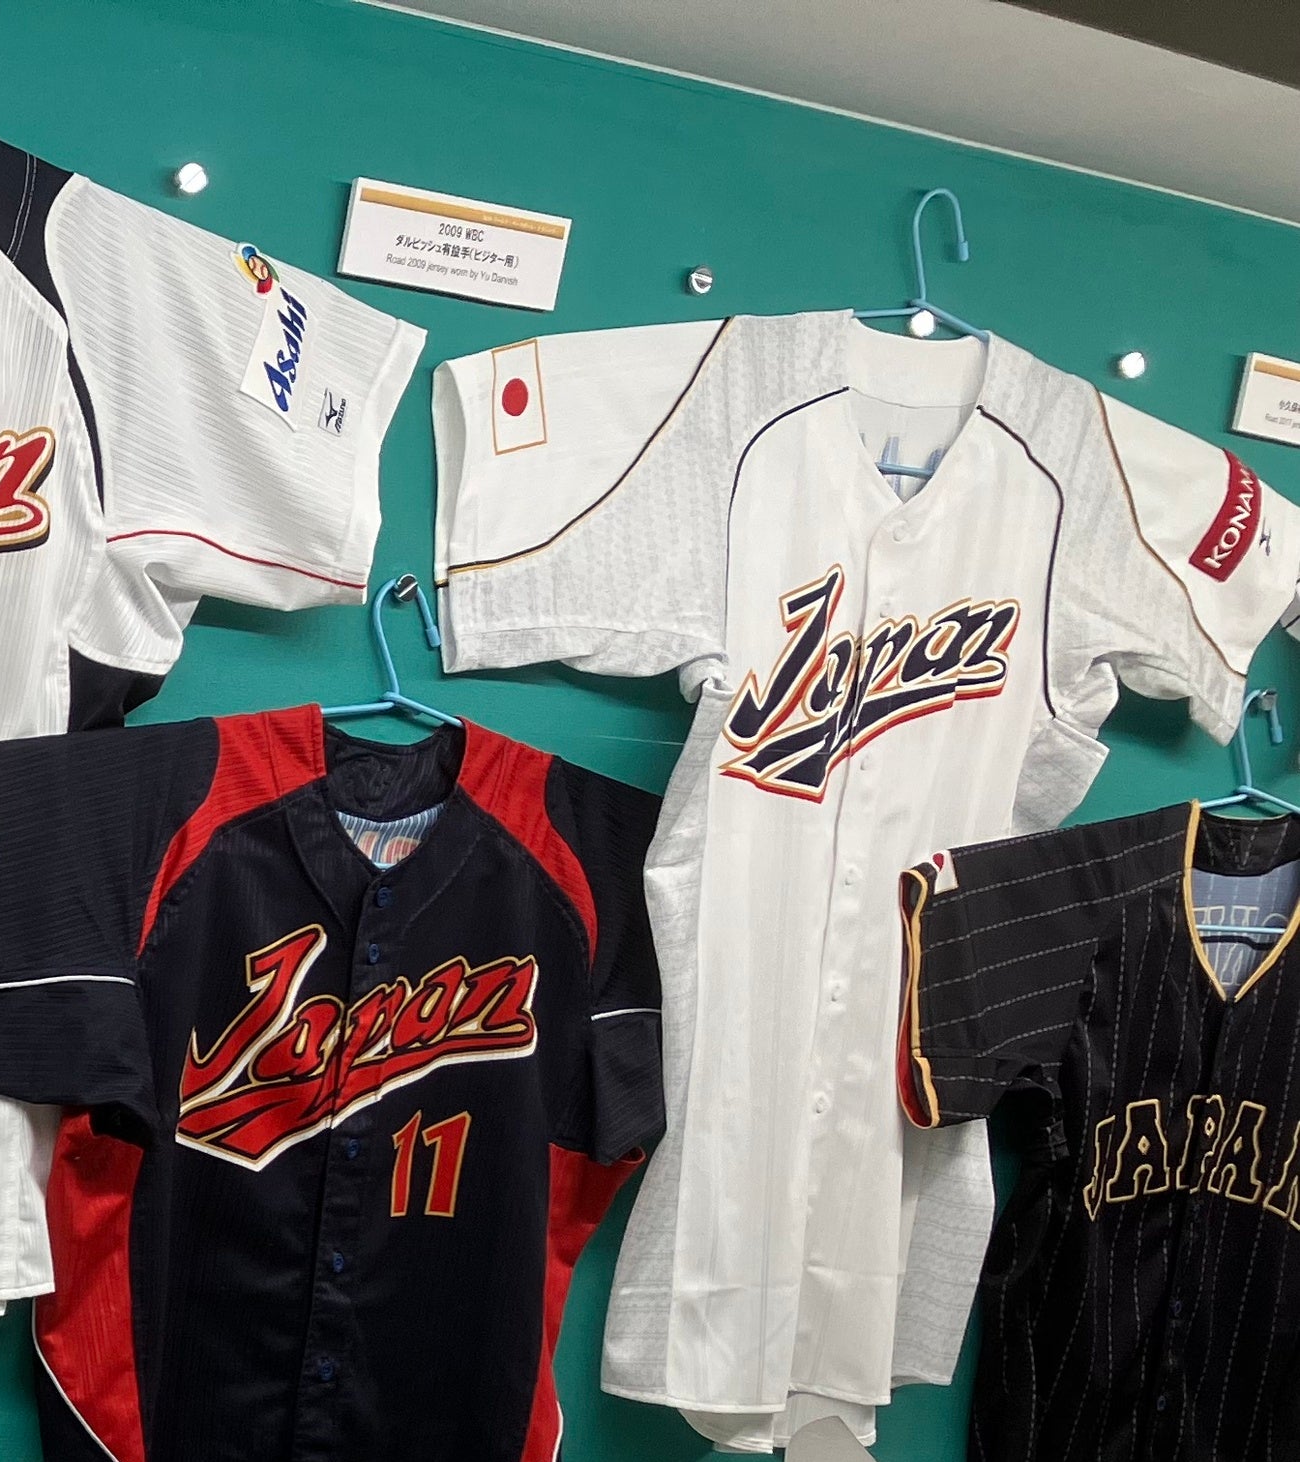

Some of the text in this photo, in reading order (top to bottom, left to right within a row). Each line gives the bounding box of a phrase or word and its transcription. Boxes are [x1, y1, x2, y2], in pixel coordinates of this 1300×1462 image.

[438, 222, 485, 243] 2009 WBC
[480, 269, 490, 281] Yu
[263, 287, 308, 412] Asahi
[719, 565, 1022, 804] Japan
[175, 923, 540, 1172] Japan
[391, 1110, 473, 1219] 11
